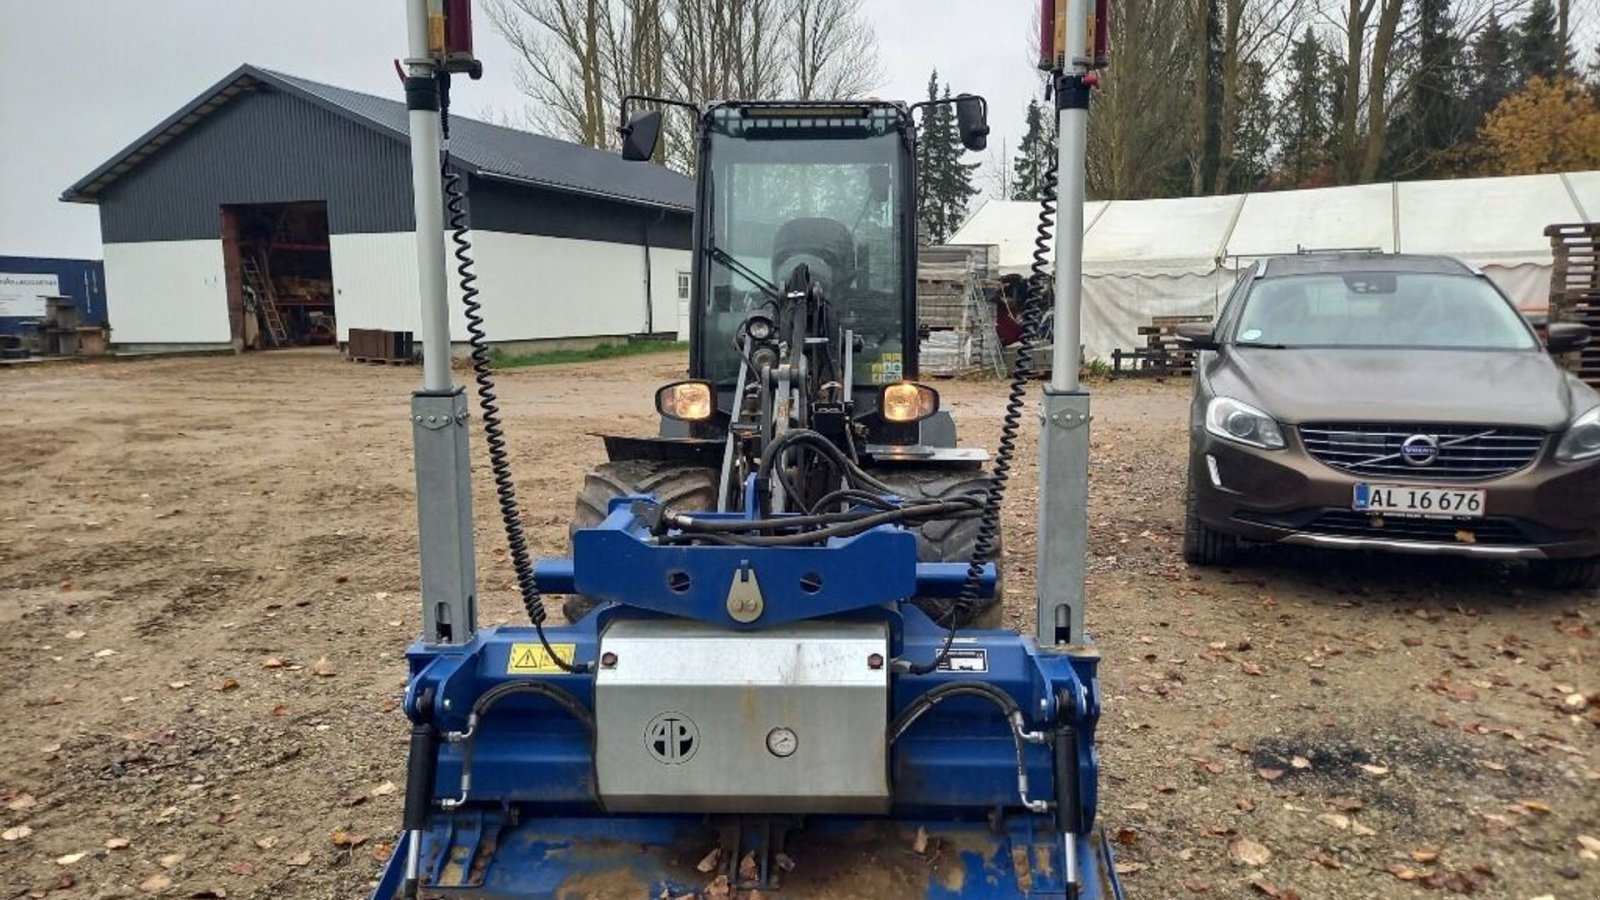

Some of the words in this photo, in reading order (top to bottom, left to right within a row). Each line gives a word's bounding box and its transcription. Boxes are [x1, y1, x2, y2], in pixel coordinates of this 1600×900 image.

[1370, 489, 1398, 508] AL
[1407, 491, 1432, 509] 16
[1439, 492, 1480, 511] 676
